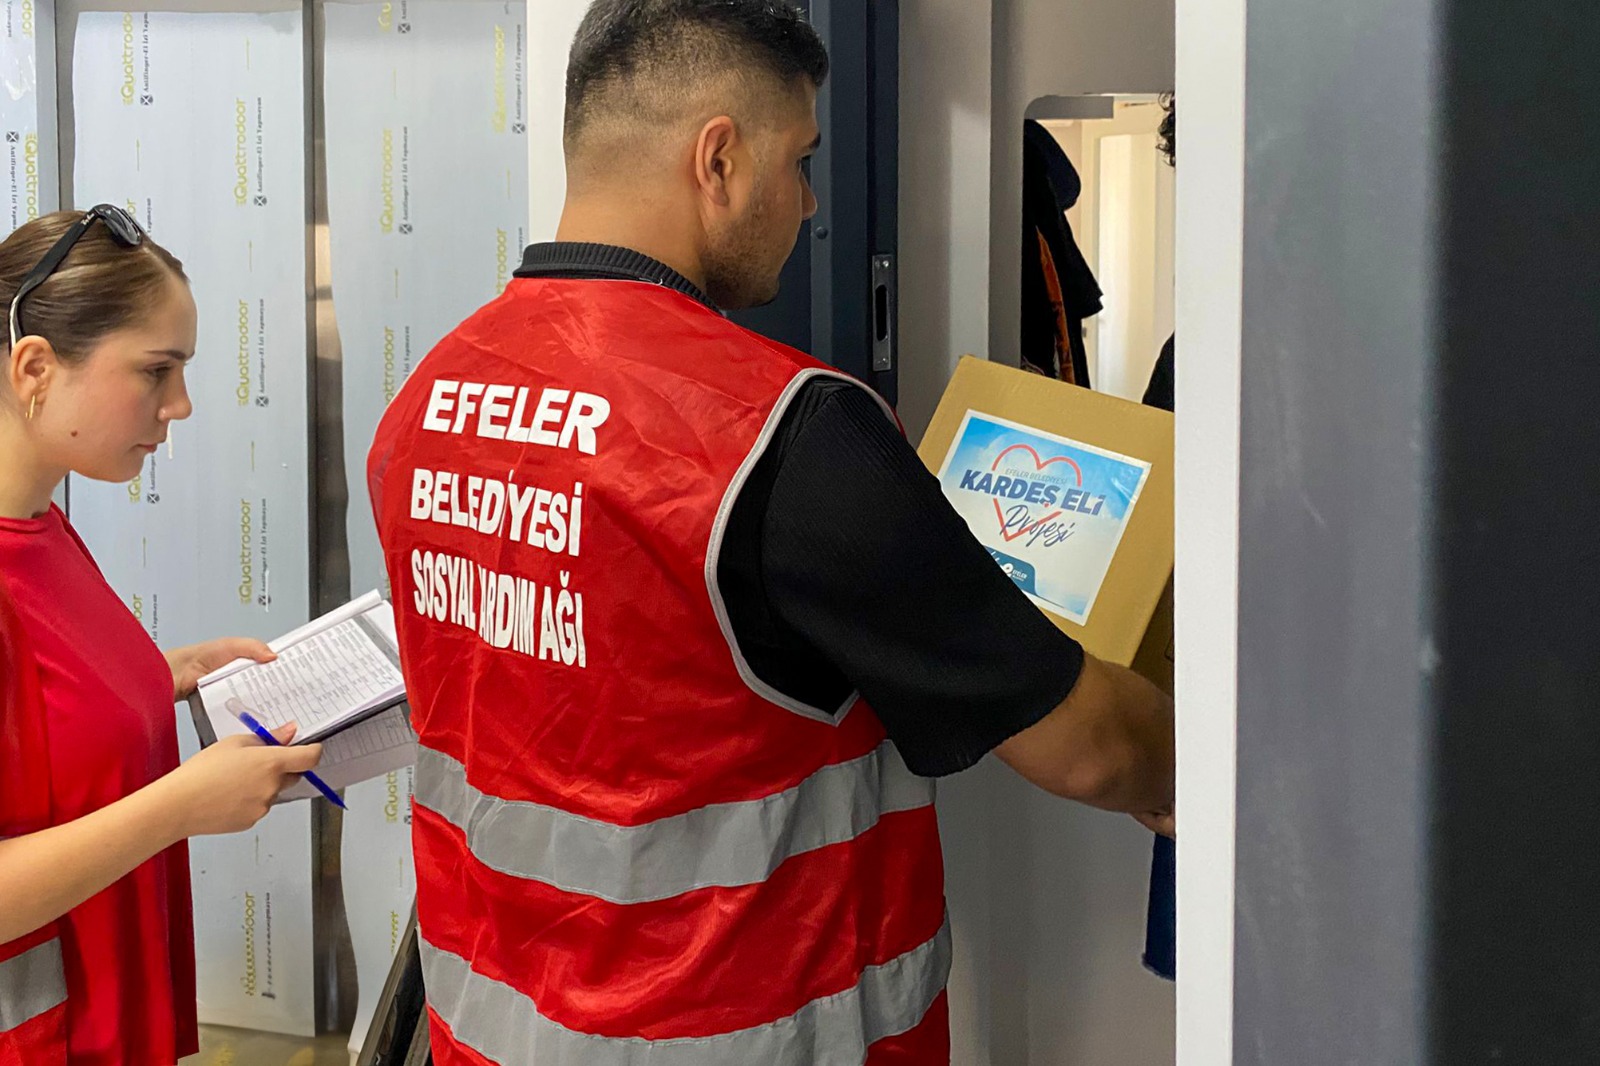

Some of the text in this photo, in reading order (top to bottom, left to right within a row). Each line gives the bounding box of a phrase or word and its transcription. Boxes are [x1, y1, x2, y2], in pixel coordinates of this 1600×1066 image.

[422, 379, 611, 455] EFELER
[959, 469, 1061, 507] KARDEŞ
[239, 499, 252, 597] Quattrodoor
[411, 548, 476, 632] SOSYAL
